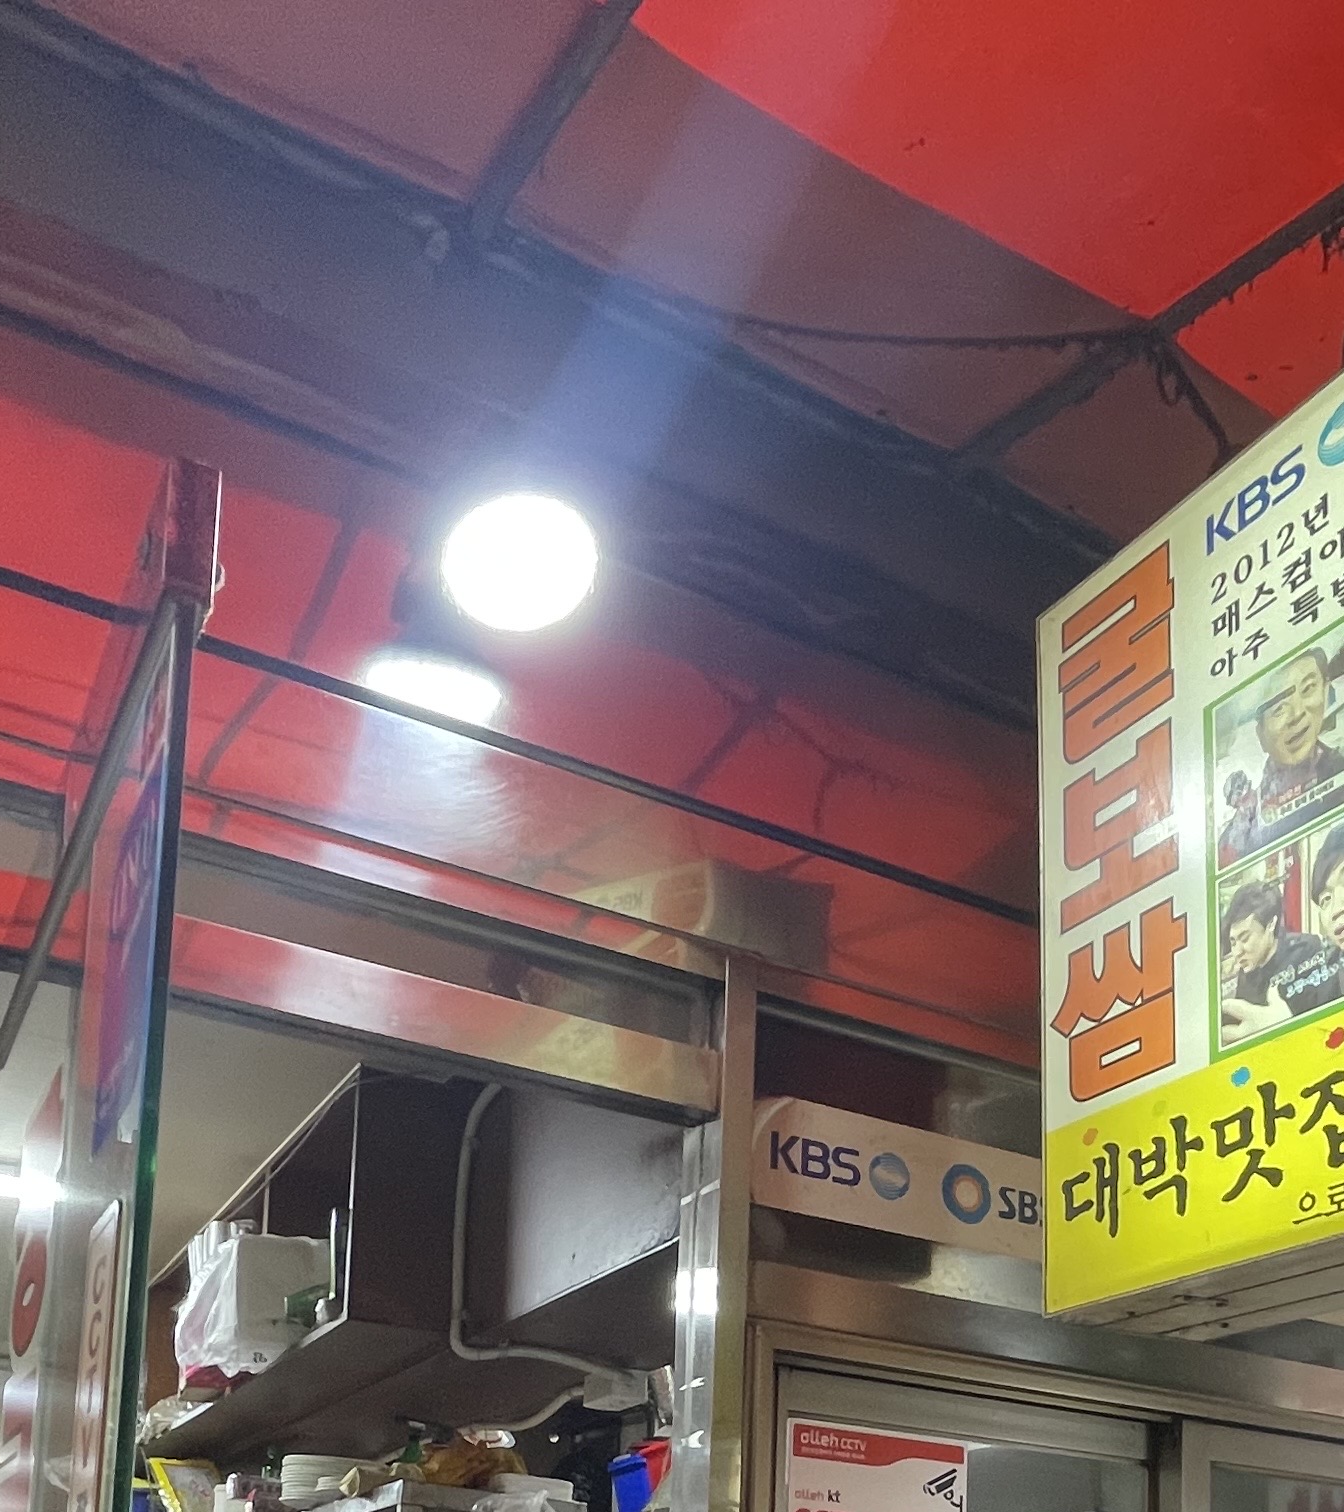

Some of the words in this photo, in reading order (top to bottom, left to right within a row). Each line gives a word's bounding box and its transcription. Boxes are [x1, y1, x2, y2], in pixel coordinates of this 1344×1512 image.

[1205, 444, 1306, 556] KBS
[1211, 494, 1330, 605] 2012년
[1209, 629, 1271, 680] 아주
[1051, 540, 1187, 1102] 굴보쌈
[769, 1130, 862, 1187] KBS
[998, 1186, 1043, 1228] SB
[827, 1489, 841, 1503] kt
